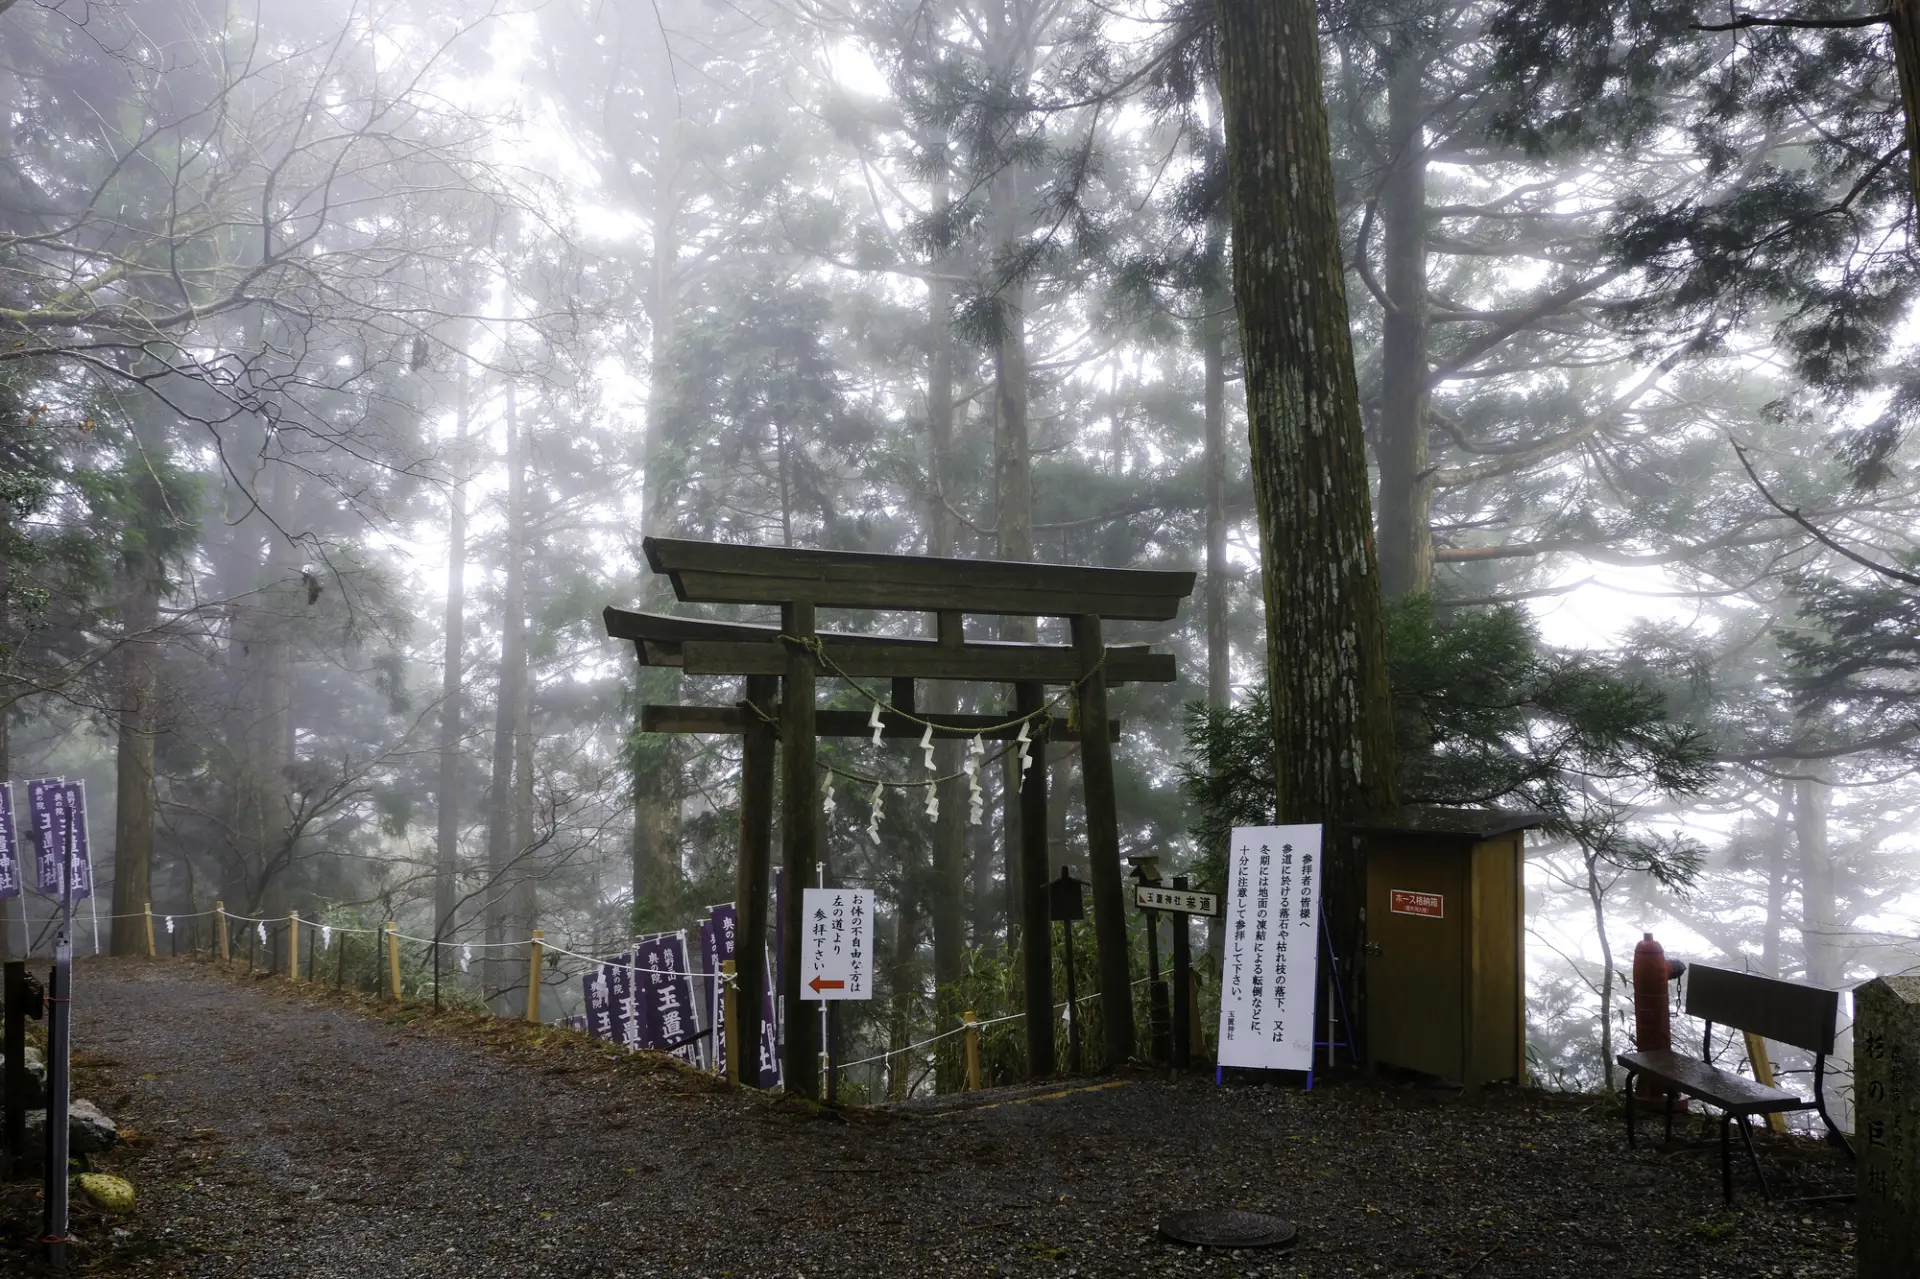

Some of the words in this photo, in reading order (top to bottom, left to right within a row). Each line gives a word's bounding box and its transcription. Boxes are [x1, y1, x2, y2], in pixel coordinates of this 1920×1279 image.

[1299, 853, 1313, 928] 参拝者の皆様へ
[813, 908, 828, 971] 参拝下さい
[832, 895, 845, 955] 左の道より
[849, 894, 864, 992] お体の不自由な方は
[1231, 845, 1250, 1001] 十分に注意して参拝して下さい。
[1251, 844, 1271, 1036] 冬期には地面の凍結による転倒などに、
[612, 966, 624, 995] 奥の院
[648, 952, 663, 985] 奥の院
[663, 948, 676, 981] 熊野三山
